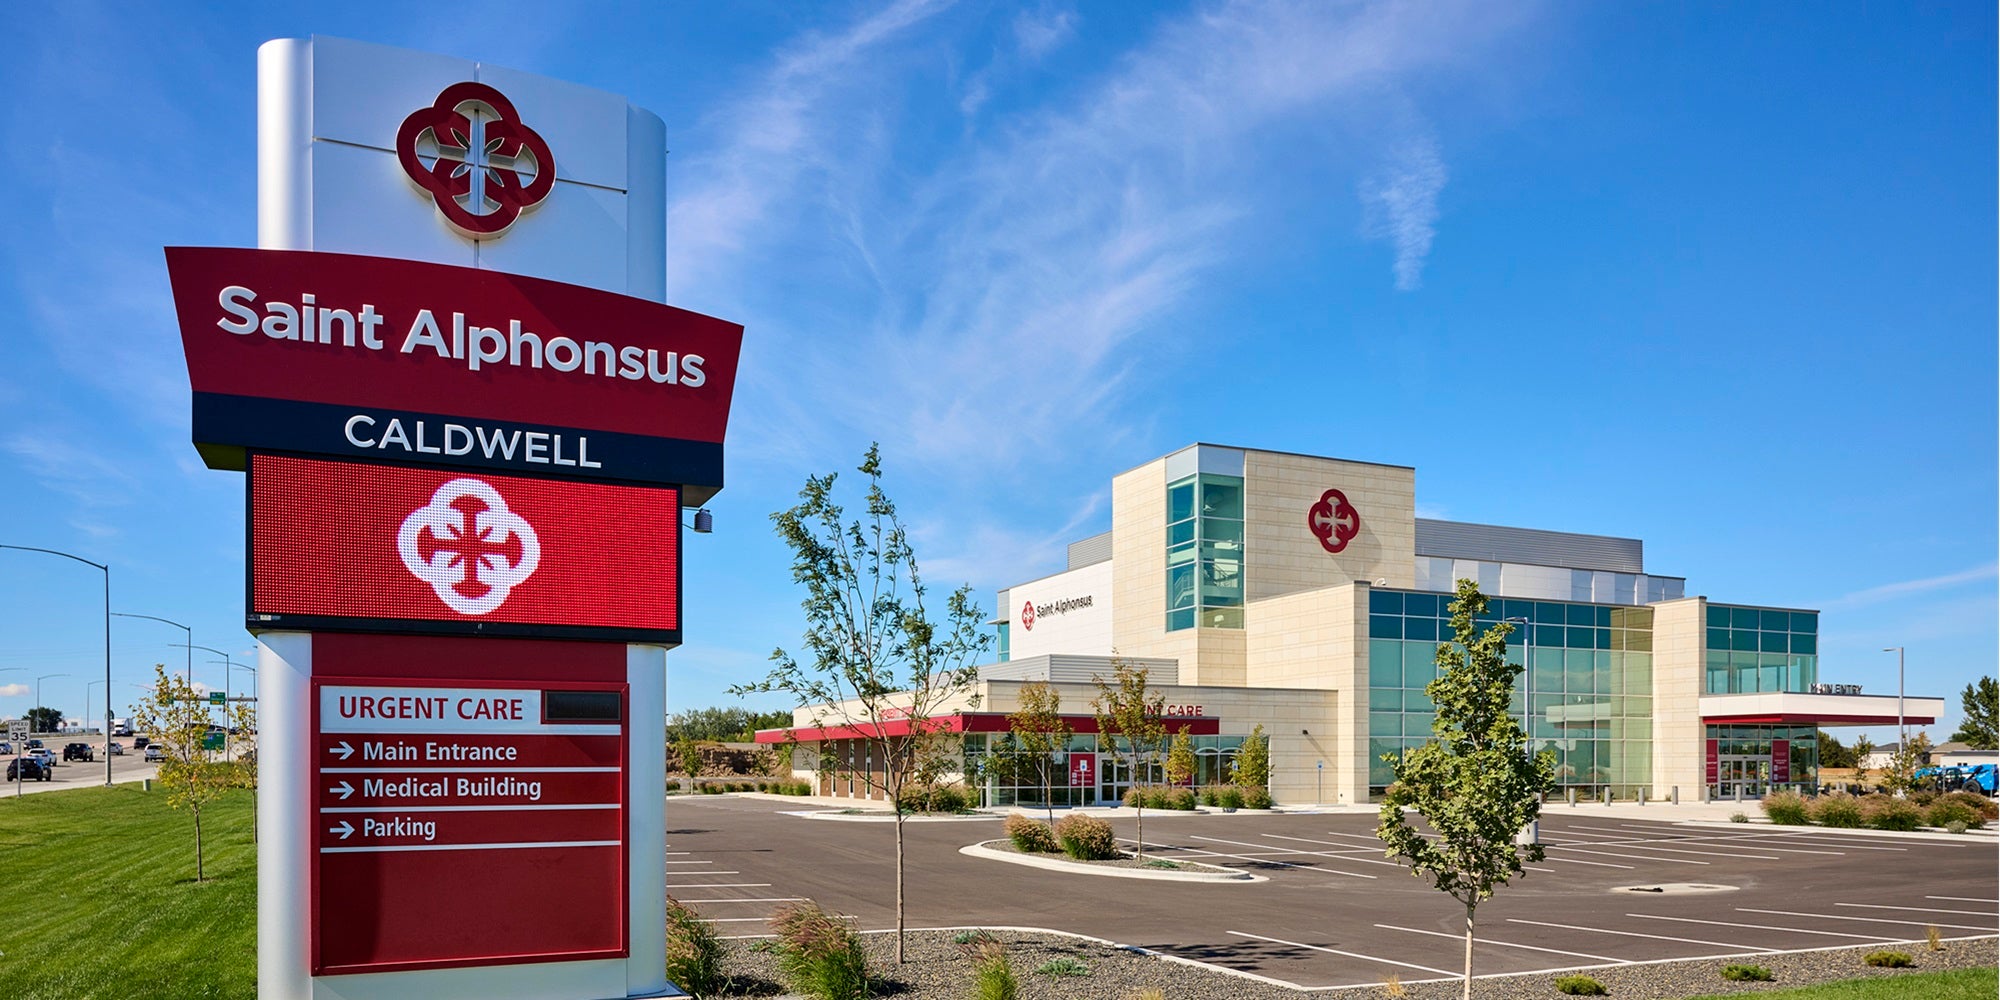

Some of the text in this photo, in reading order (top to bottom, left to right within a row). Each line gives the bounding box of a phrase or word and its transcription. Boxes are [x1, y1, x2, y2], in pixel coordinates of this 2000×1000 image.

[216, 285, 707, 388] Saint Alphonsus
[344, 414, 602, 469] CALDWELL
[1036, 594, 1094, 619] Saint Alphonsus
[1809, 683, 1863, 696] MAIN ENTRY
[339, 696, 524, 720] URGENT CARE
[1167, 704, 1203, 717] CARE
[11, 732, 28, 741] 35
[363, 741, 518, 761] Main Entrance
[363, 776, 543, 801] Medical Building
[363, 817, 436, 841] Parking
